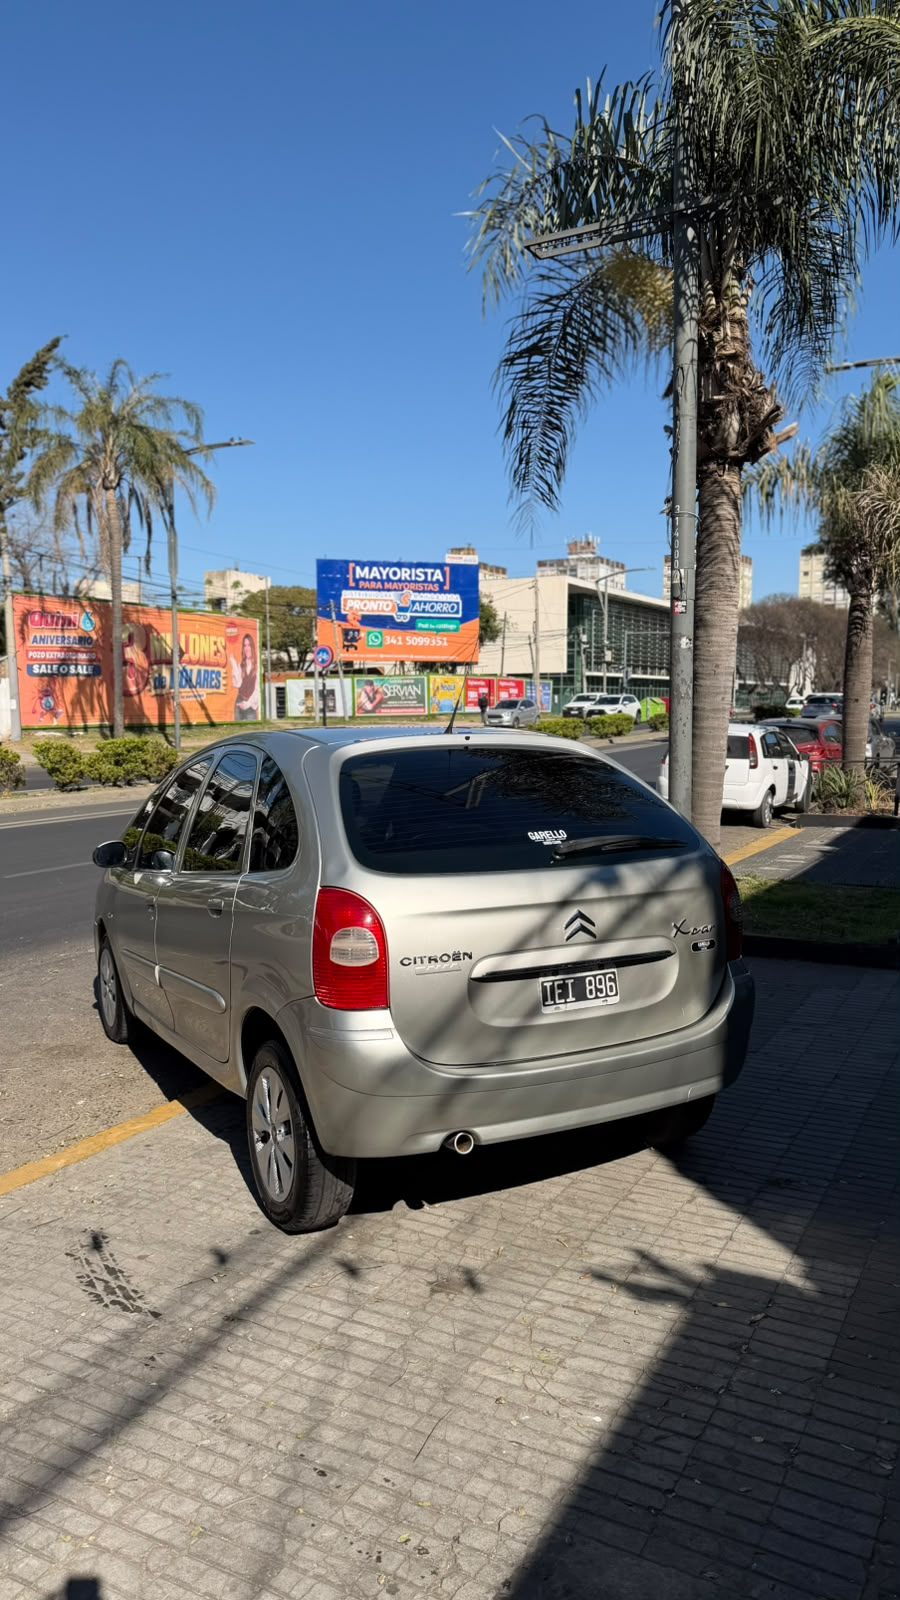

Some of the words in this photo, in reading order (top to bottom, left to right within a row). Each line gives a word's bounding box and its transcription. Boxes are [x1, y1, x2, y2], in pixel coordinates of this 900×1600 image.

[355, 566, 444, 582] MAYORISTA
[359, 581, 383, 590] PARA
[384, 582, 439, 592] MAYORISTAS
[346, 599, 392, 611] PRONTO
[412, 602, 458, 613] AHORRO
[32, 635, 94, 646] ANIVERSARIO
[385, 636, 403, 645] 341
[28, 651, 45, 659] POZO
[32, 664, 58, 674] SALE
[69, 665, 94, 674] SALE
[527, 829, 568, 841] GARELLO
[399, 950, 473, 967] CITROËN
[543, 978, 576, 1006] IEI
[585, 973, 617, 999] 896
